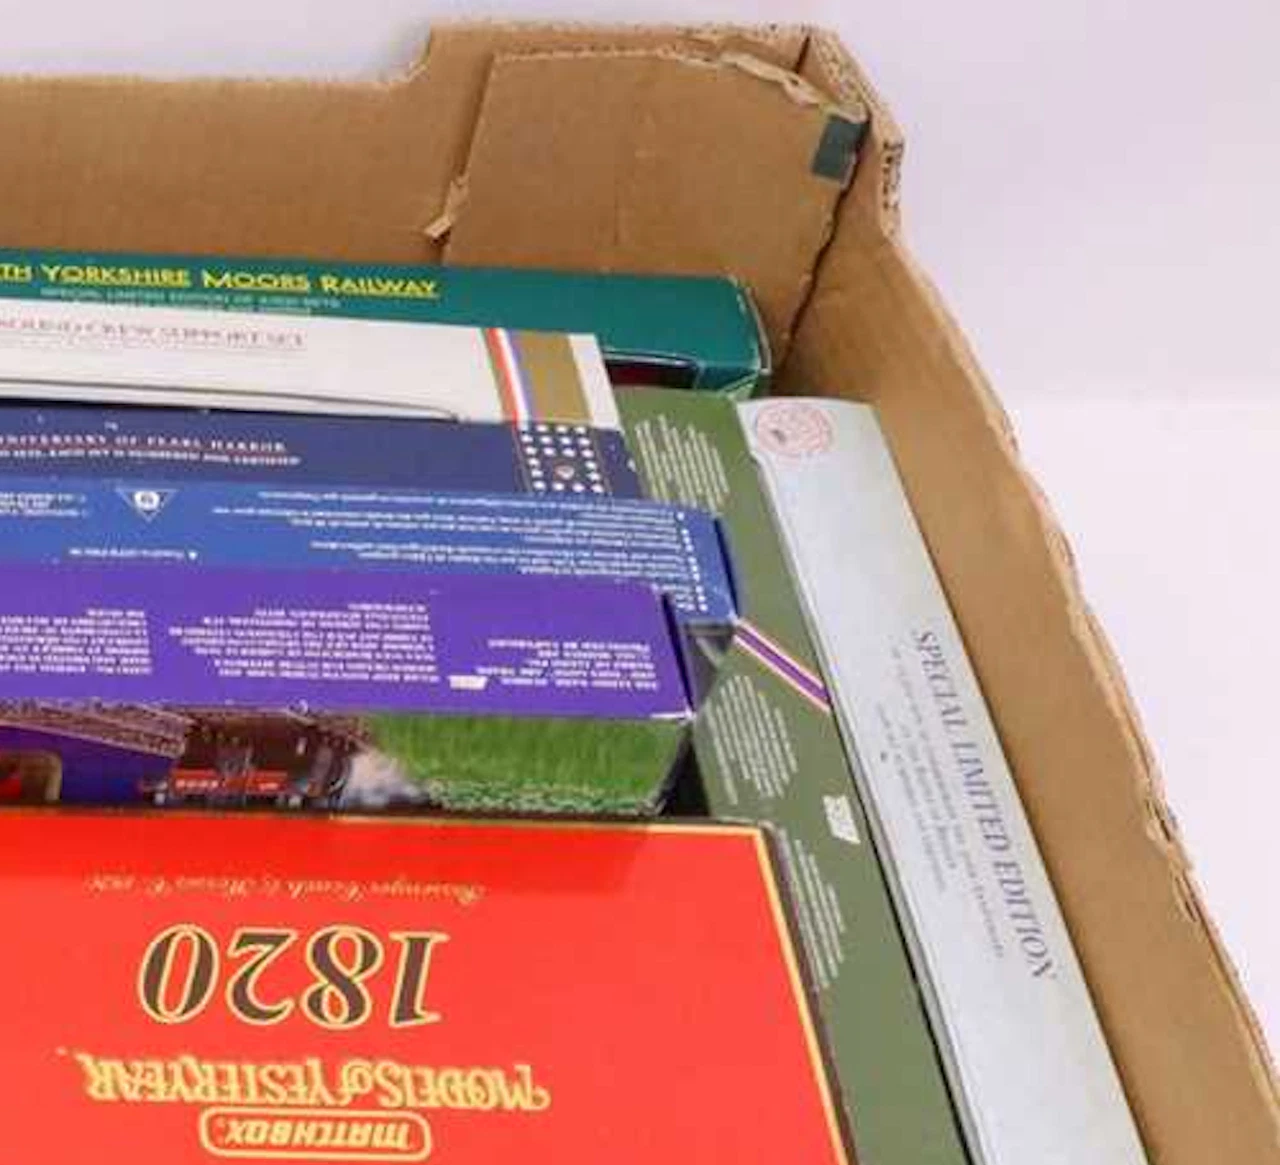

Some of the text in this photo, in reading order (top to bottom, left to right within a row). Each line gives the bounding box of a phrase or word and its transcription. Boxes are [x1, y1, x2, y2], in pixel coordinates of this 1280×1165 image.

[41, 263, 190, 289] YORKSHIRE
[202, 269, 310, 293] MOORS
[319, 274, 438, 299] RAILWAY
[915, 627, 968, 745] SPECIAL
[950, 742, 1012, 858] LIMITED
[992, 856, 1060, 980] EDITION
[137, 923, 450, 1031] 1820
[76, 1052, 551, 1112] MODELS of YESTERYEAR
[220, 1119, 414, 1152] MATCHBOX
